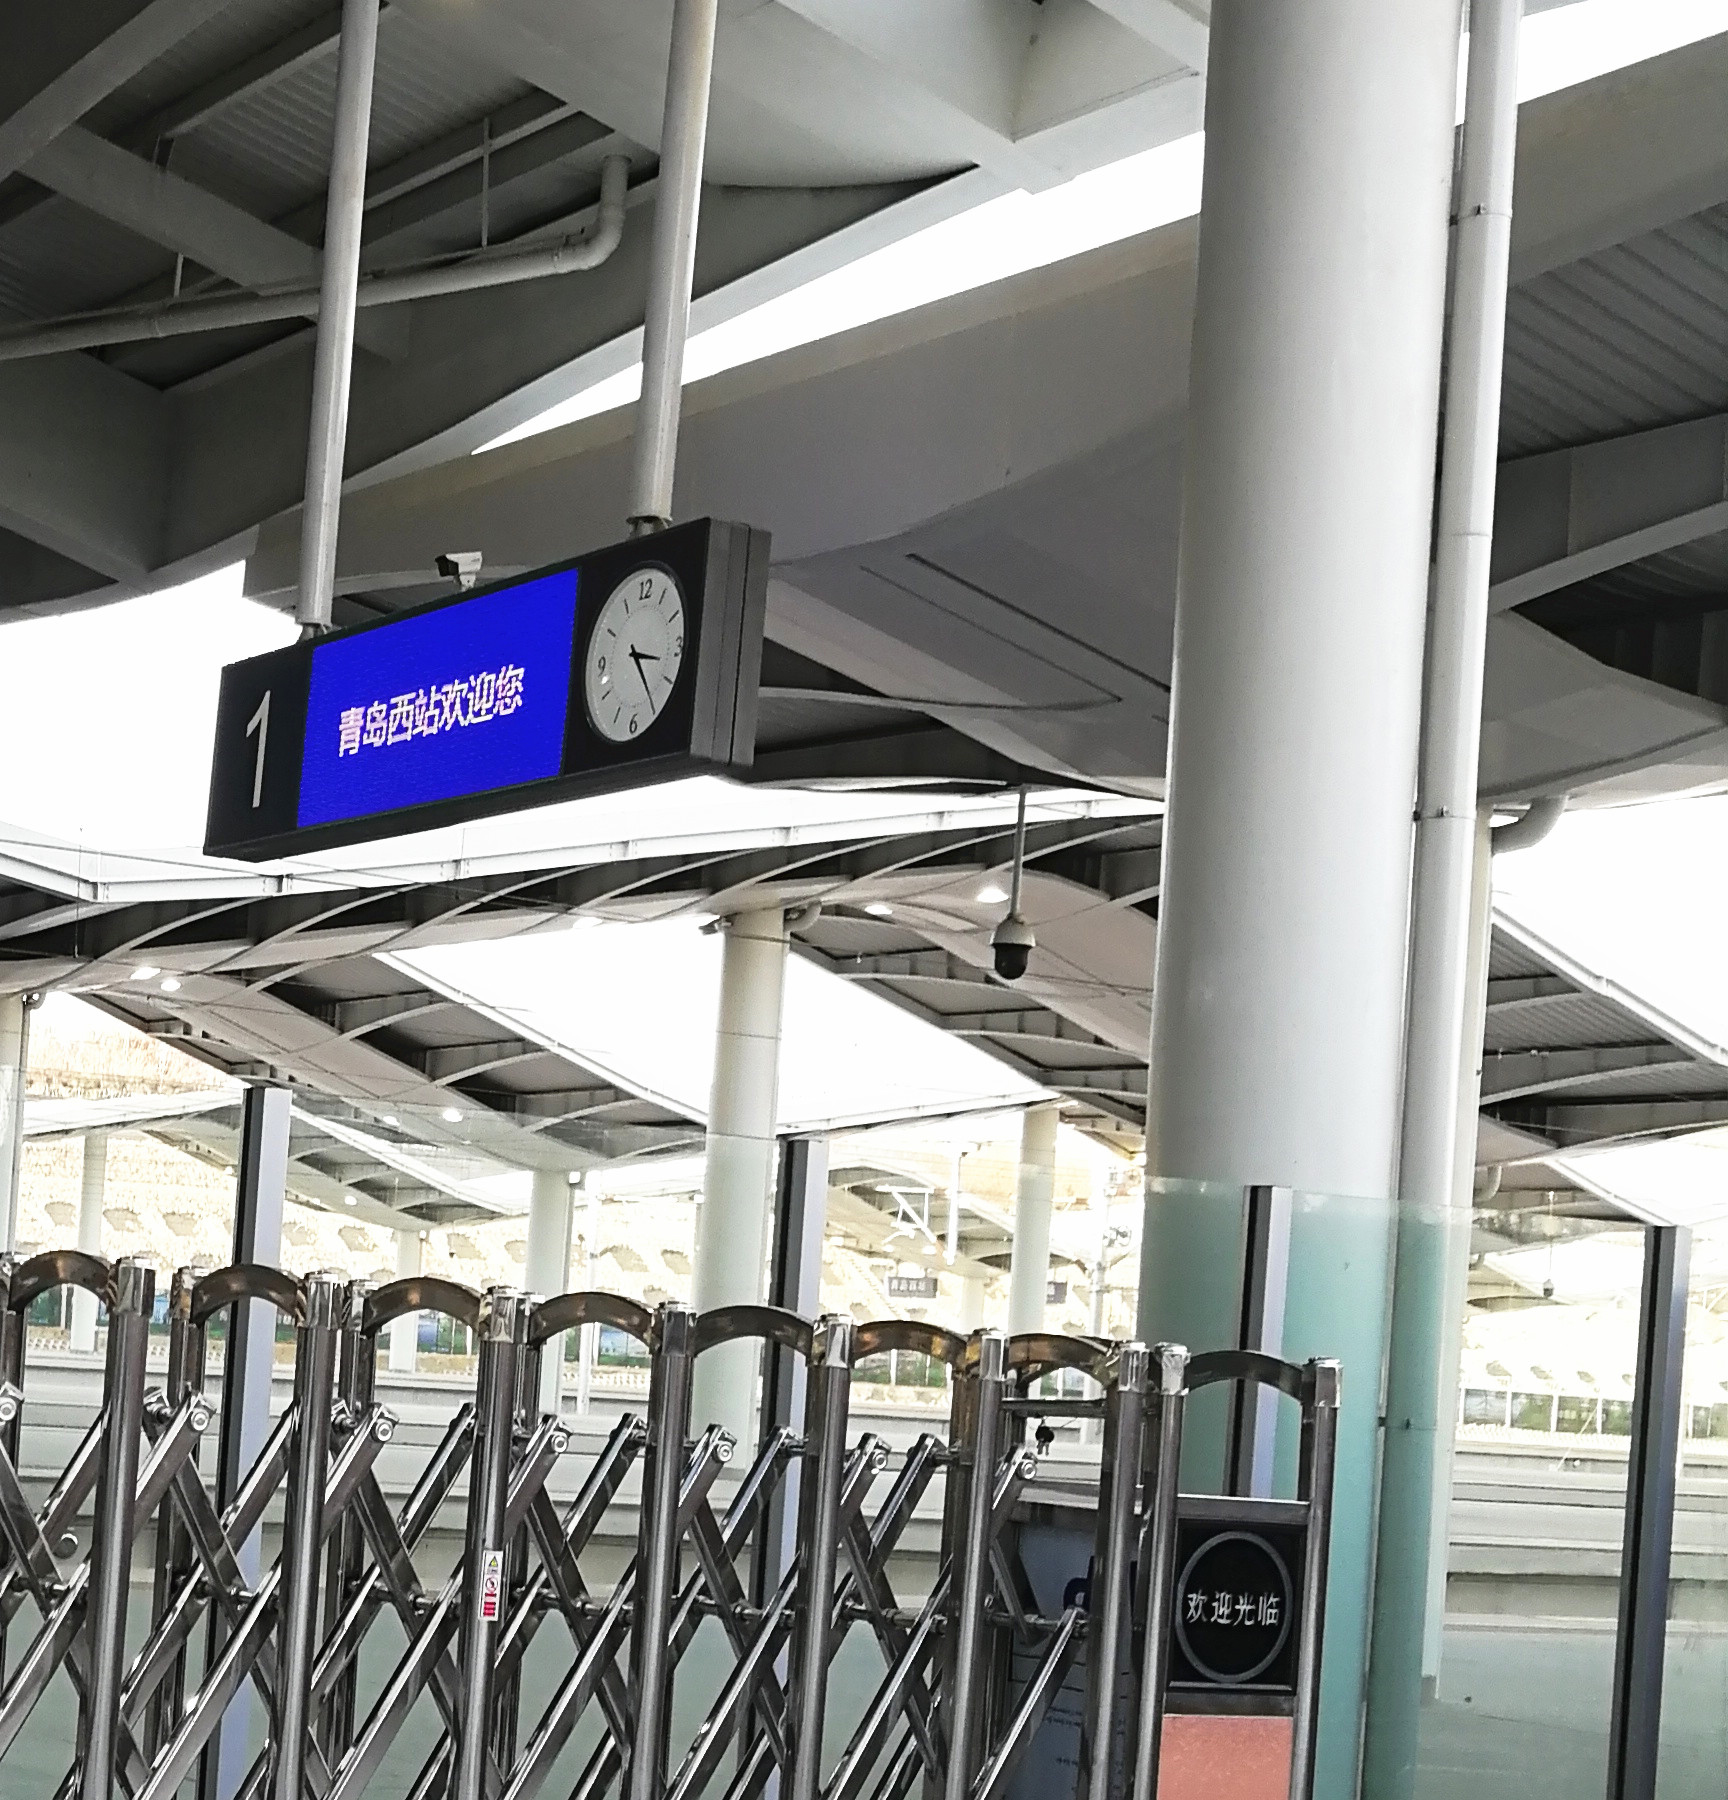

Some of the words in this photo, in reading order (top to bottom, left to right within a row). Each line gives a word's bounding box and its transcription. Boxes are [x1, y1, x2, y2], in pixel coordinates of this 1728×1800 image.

[638, 578, 653, 601] 12
[673, 635, 683, 657] 3
[597, 656, 607, 677] 9
[339, 664, 525, 757] 青岛西站欢迎您
[628, 713, 638, 734] 6
[246, 689, 271, 809] 1
[1186, 1589, 1281, 1627] 欢迎光临
